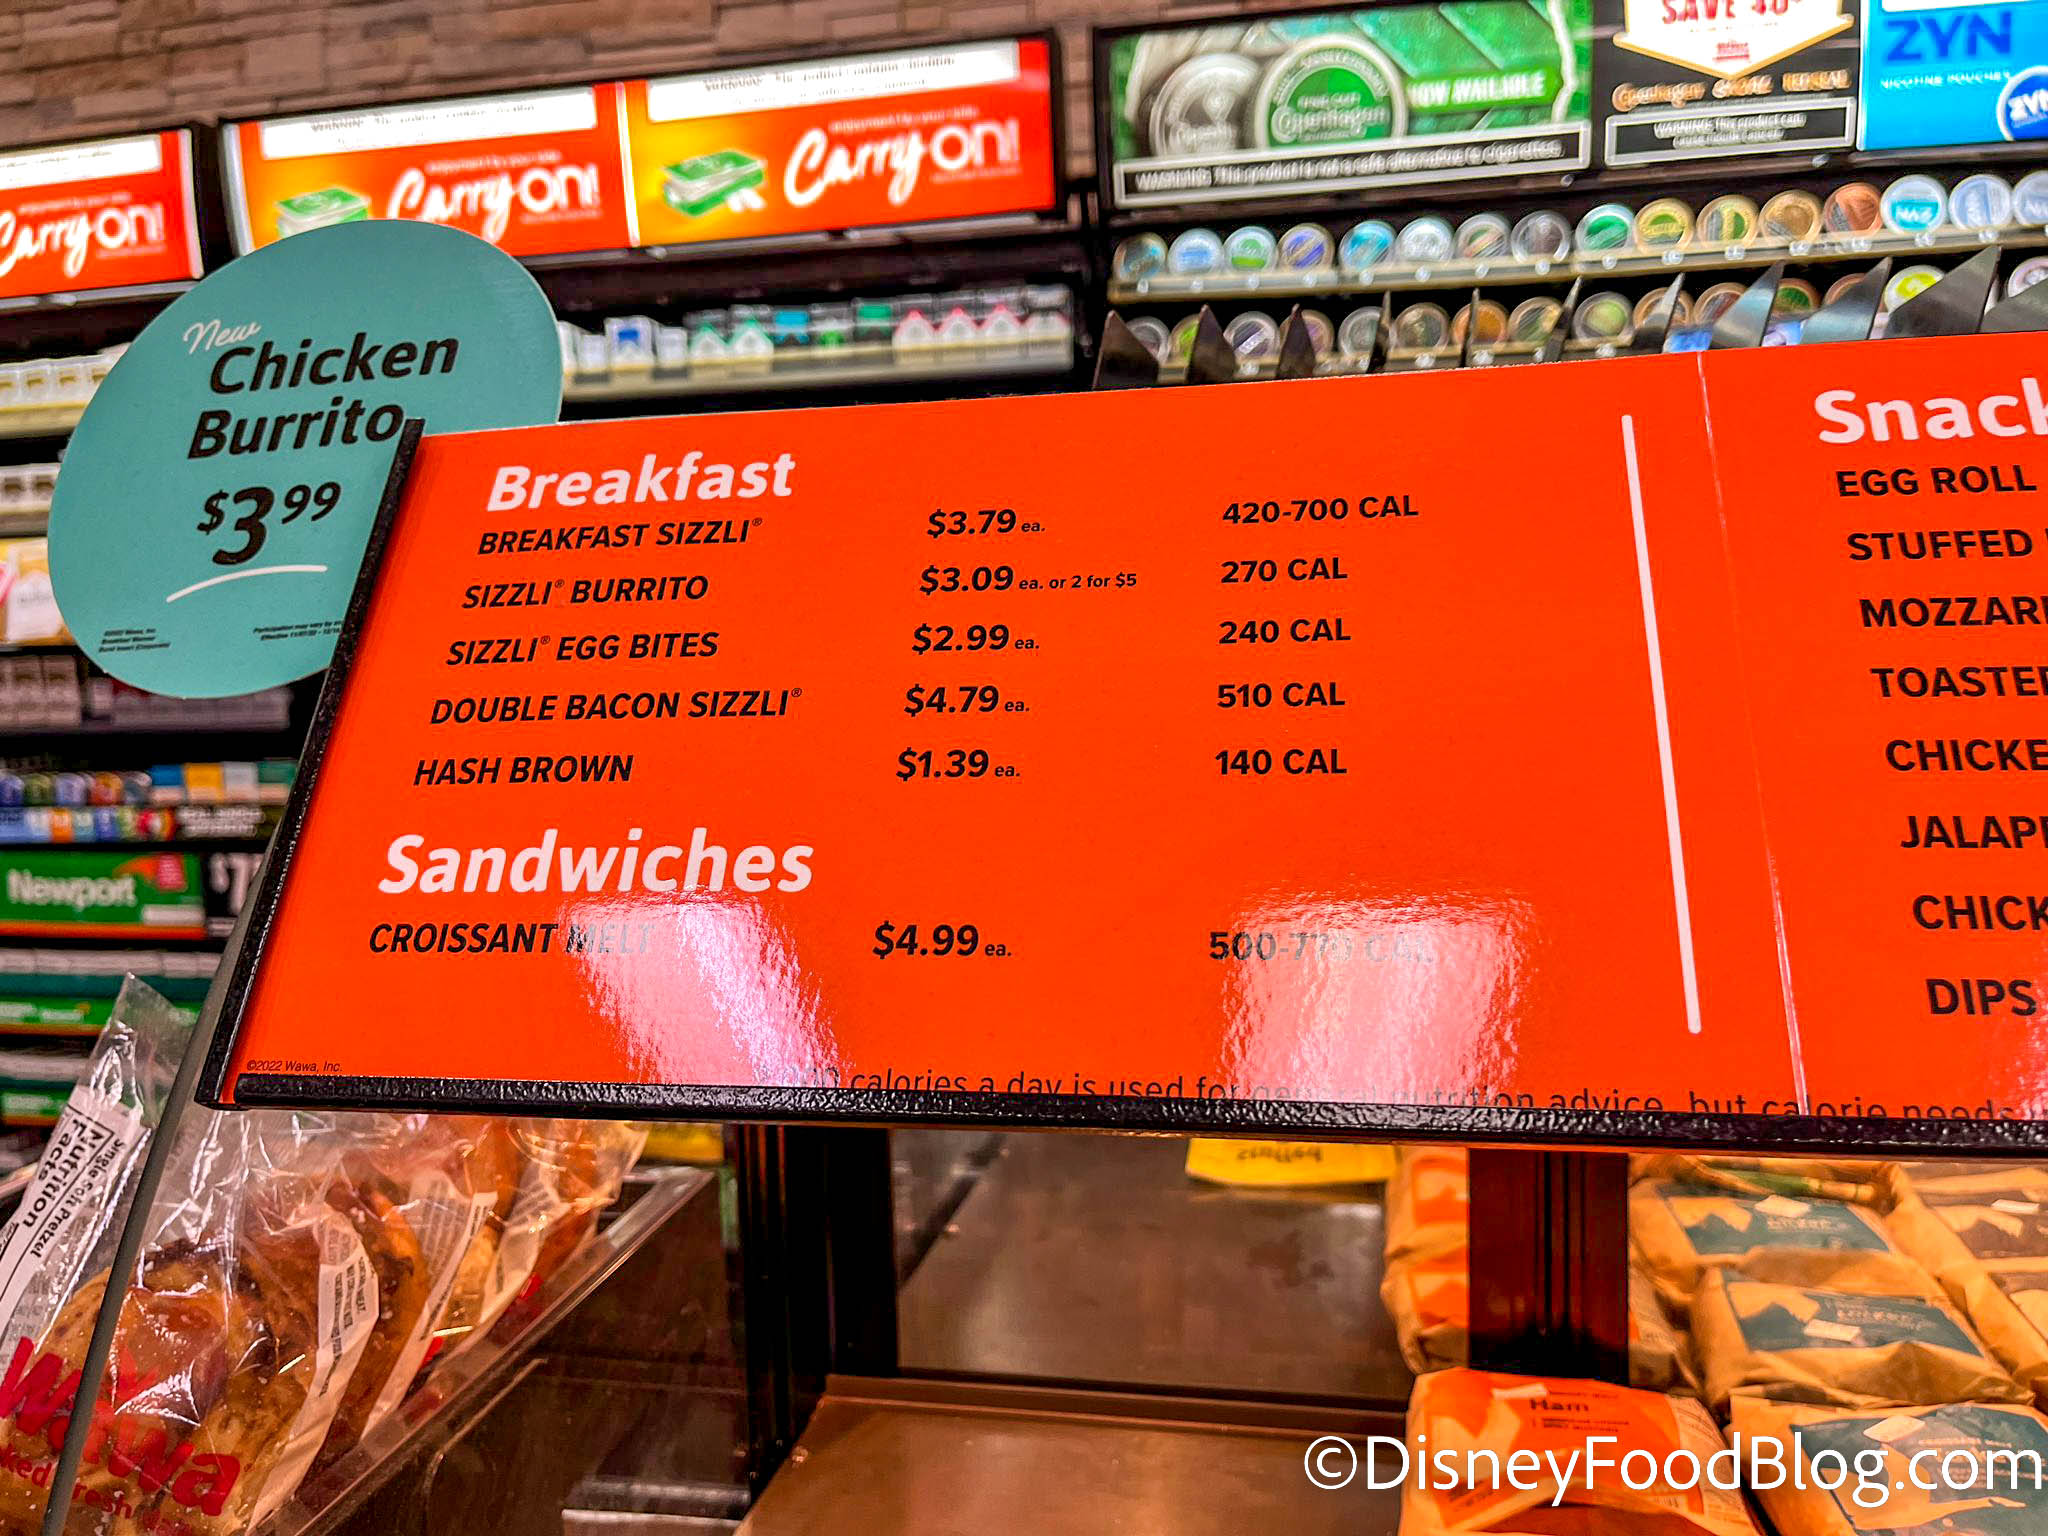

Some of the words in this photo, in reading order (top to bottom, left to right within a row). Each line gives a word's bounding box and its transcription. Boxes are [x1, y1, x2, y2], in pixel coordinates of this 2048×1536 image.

[1885, 11, 2012, 62] ZYN
[183, 320, 261, 355] New
[210, 332, 459, 395] Chicken
[187, 393, 404, 460] Burrito
[485, 450, 797, 513] Breakfast
[1836, 467, 1920, 498] EGG
[1931, 464, 2038, 495] ROLL
[926, 508, 1017, 540] $3.79
[1020, 518, 1047, 533] ea.
[1221, 496, 1350, 525] 420-700
[1357, 494, 1420, 519] CAL
[477, 522, 650, 556] BREAKFAST
[1846, 528, 2034, 562] STUFFED
[919, 564, 1015, 597] $3.09
[1018, 577, 1045, 591] ea.
[1048, 575, 1068, 590] or
[1070, 574, 1083, 589] 2
[1086, 572, 1112, 589] for
[1114, 571, 1139, 591] $5
[1219, 558, 1279, 585] 270
[1286, 556, 1349, 582] CAL
[569, 574, 710, 604] BURRITO
[555, 634, 621, 662] EGG
[628, 630, 721, 660] BITES
[911, 622, 1011, 657] $2.99
[1014, 636, 1041, 651] ea.
[1217, 618, 1281, 646] 240
[1289, 617, 1352, 643] CAL
[429, 695, 559, 726] DOUBLE
[564, 691, 682, 721] BACON
[904, 683, 1001, 718] $4.79
[1004, 698, 1031, 713] ea.
[1216, 682, 1274, 710] 510
[1281, 680, 1347, 708] CAL
[412, 755, 503, 787] HASH
[508, 753, 636, 785] BROWN
[896, 746, 990, 782] $1.39
[994, 763, 1021, 779] ea.
[1214, 748, 1274, 776] 140
[1281, 747, 1349, 776] CAL
[378, 827, 815, 895] Sandwiches
[8, 867, 138, 913] Newport
[368, 922, 559, 954] CROISSANT
[565, 923, 656, 955] MELT
[872, 920, 980, 961] $4.99
[984, 940, 1013, 958] ea.
[1926, 977, 2038, 1017] DIPS
[284, 1060, 319, 1074] Wawa,
[321, 1061, 344, 1073] Inc.
[850, 1068, 967, 1092] calories
[979, 1075, 994, 1093] a
[1074, 1072, 1098, 1096] is
[1109, 1076, 1183, 1099] used
[1195, 1077, 1241, 1099] for
[1689, 1091, 1747, 1114] but
[38, 1119, 88, 1182] Facts
[22, 1127, 106, 1229] Nutrition
[30, 1205, 71, 1258] Pretzel
[1528, 1396, 1591, 1413] Ham
[70, 1482, 134, 1521] resh
